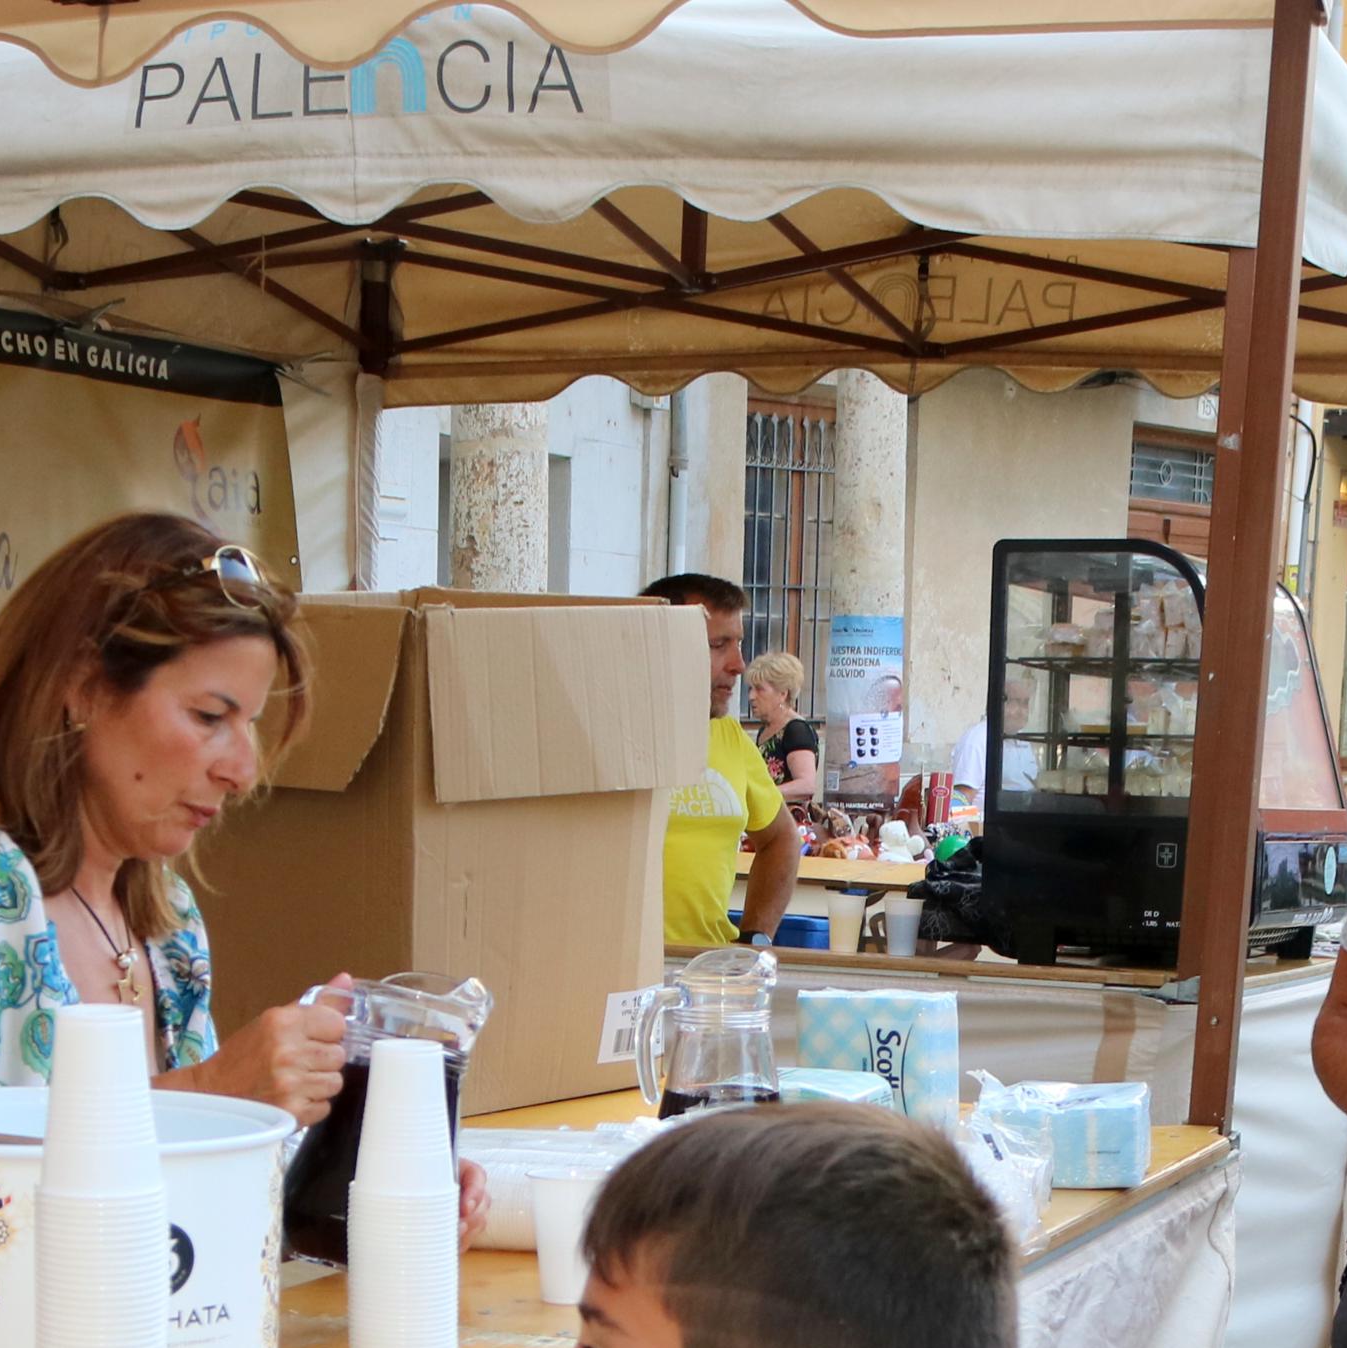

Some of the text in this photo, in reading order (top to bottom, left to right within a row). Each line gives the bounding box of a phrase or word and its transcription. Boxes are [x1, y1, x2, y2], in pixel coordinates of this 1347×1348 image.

[54, 338, 80, 363] EN
[86, 346, 169, 380] GALICIA
[841, 657, 881, 667] CONDENA
[836, 669, 865, 678] OLVIDO
